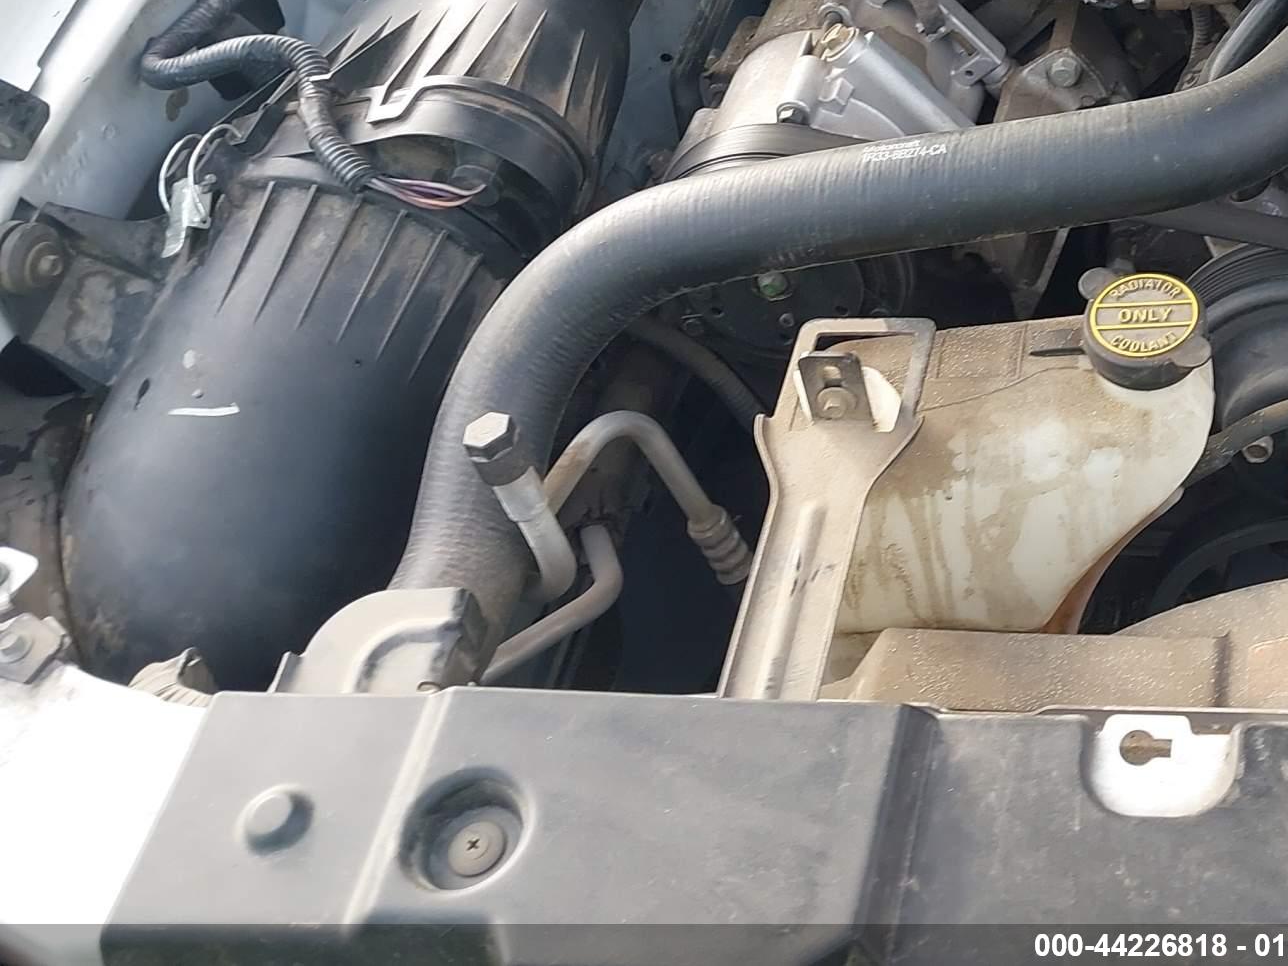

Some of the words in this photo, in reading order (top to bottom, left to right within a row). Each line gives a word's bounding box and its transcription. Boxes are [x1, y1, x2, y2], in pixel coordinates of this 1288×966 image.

[1109, 278, 1182, 300] RADIATOR
[1118, 306, 1173, 323] ONLY
[1109, 330, 1178, 353] COOLANT
